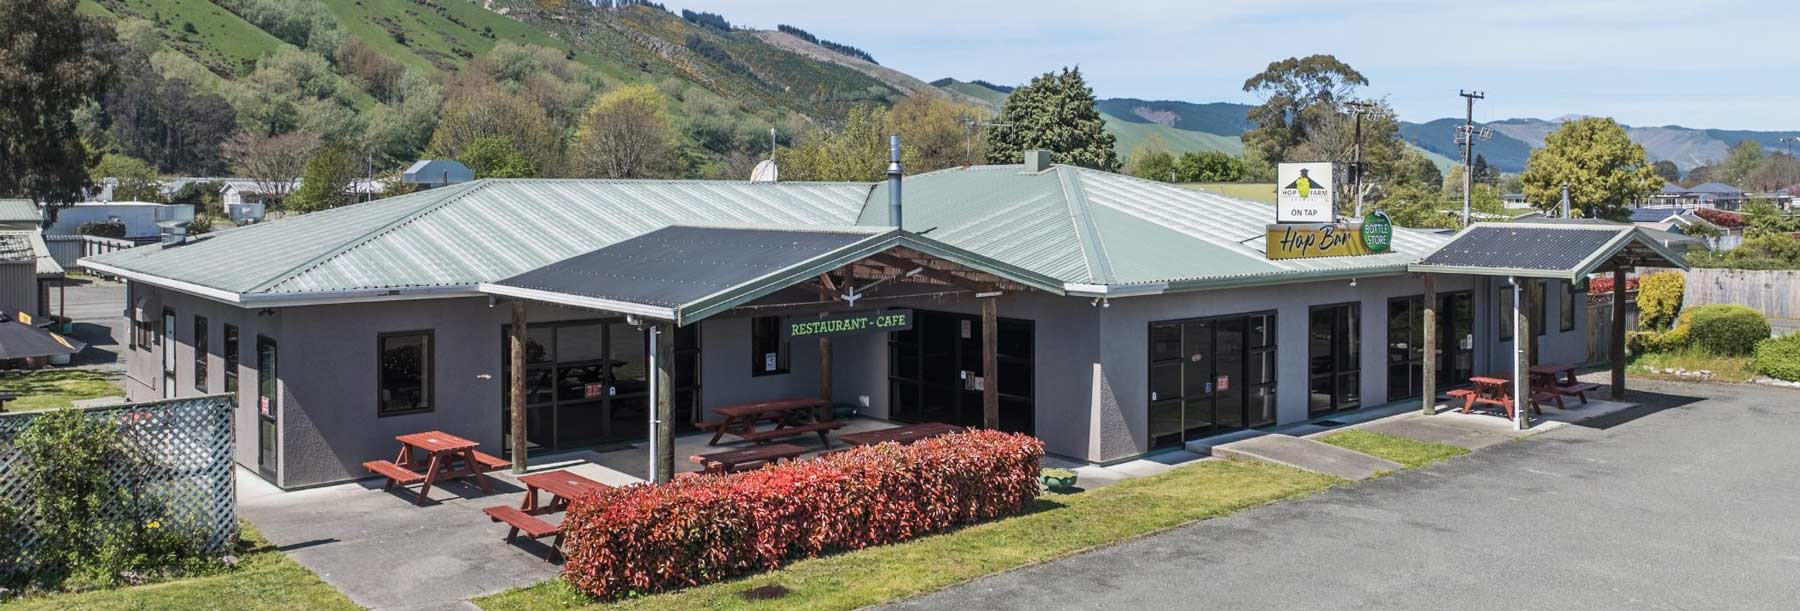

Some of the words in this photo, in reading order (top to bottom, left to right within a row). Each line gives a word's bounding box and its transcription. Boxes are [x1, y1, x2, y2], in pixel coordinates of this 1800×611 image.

[1365, 224, 1388, 234] BOTTLE
[1280, 226, 1315, 256] Hop
[1319, 225, 1350, 250] Bar
[1367, 235, 1386, 245] STORE
[791, 318, 868, 336] RESTAURANT
[876, 315, 905, 327] CAFE
